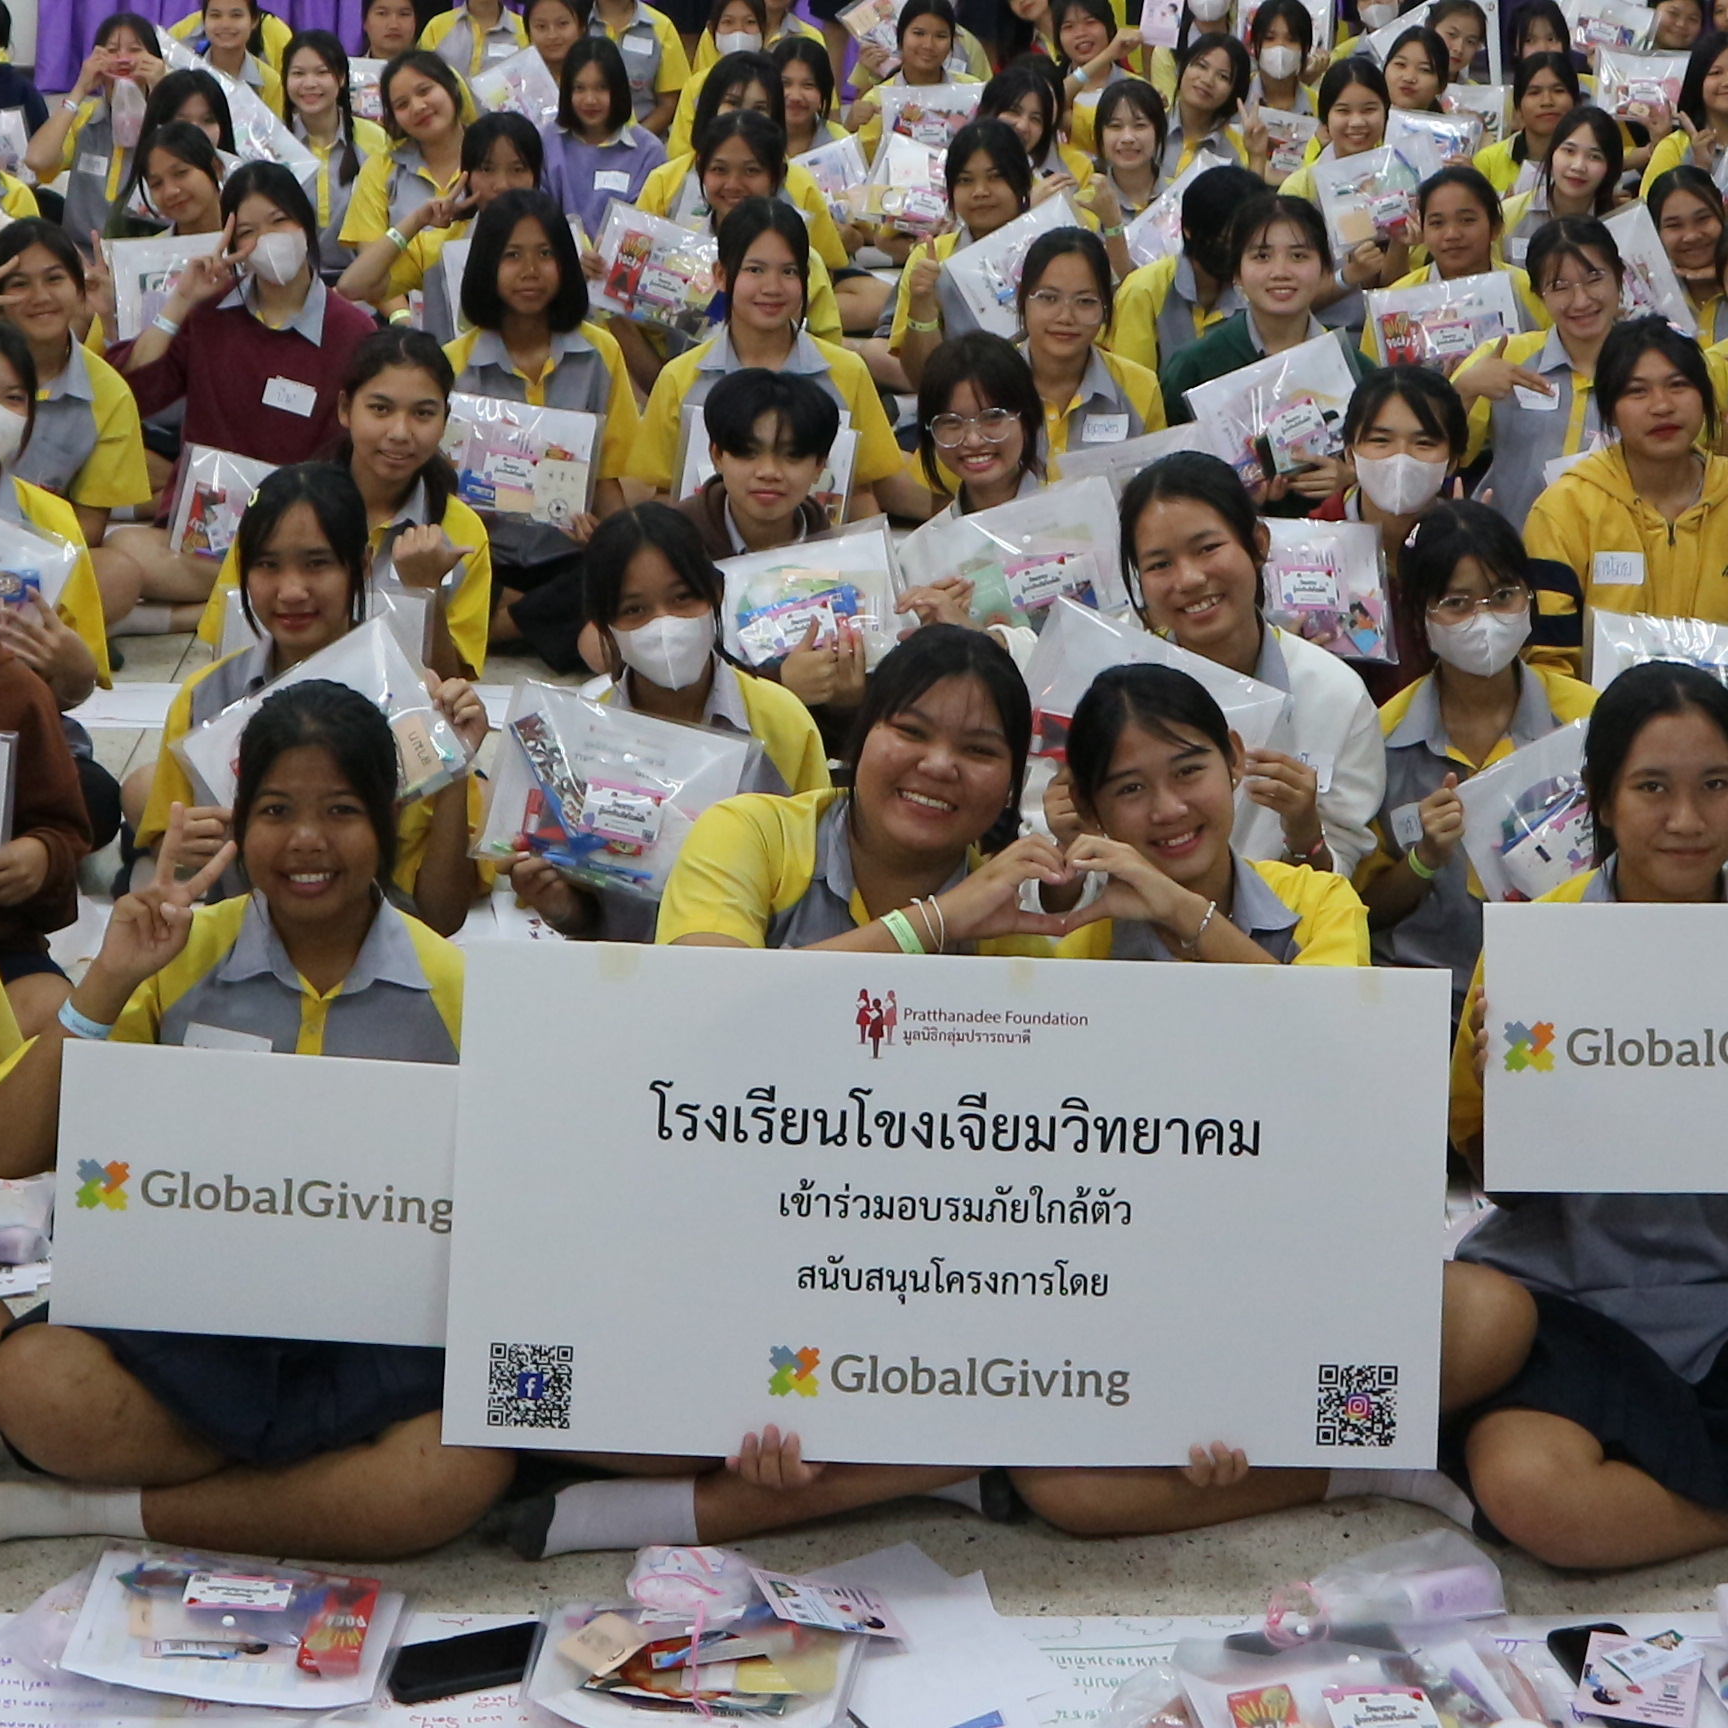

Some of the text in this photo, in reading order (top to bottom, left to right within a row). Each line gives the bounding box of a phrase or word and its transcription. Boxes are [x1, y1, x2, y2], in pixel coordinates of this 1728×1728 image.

[902, 1026, 1032, 1048] มูลนิธิกลุ่มปรารถนาดี
[903, 1007, 1090, 1026] Pratthanadee Foundation
[648, 1078, 1262, 1158] โรงเรียนโขงเจียมวิทยาคม
[139, 1168, 454, 1235] GlobalGiving
[778, 1177, 1133, 1227] เข้าร่วมอบรมภัยใกล้ตัว
[796, 1254, 1110, 1307] สนับสนุนโครงการโดย
[829, 1353, 1131, 1408] GlobalGiving
